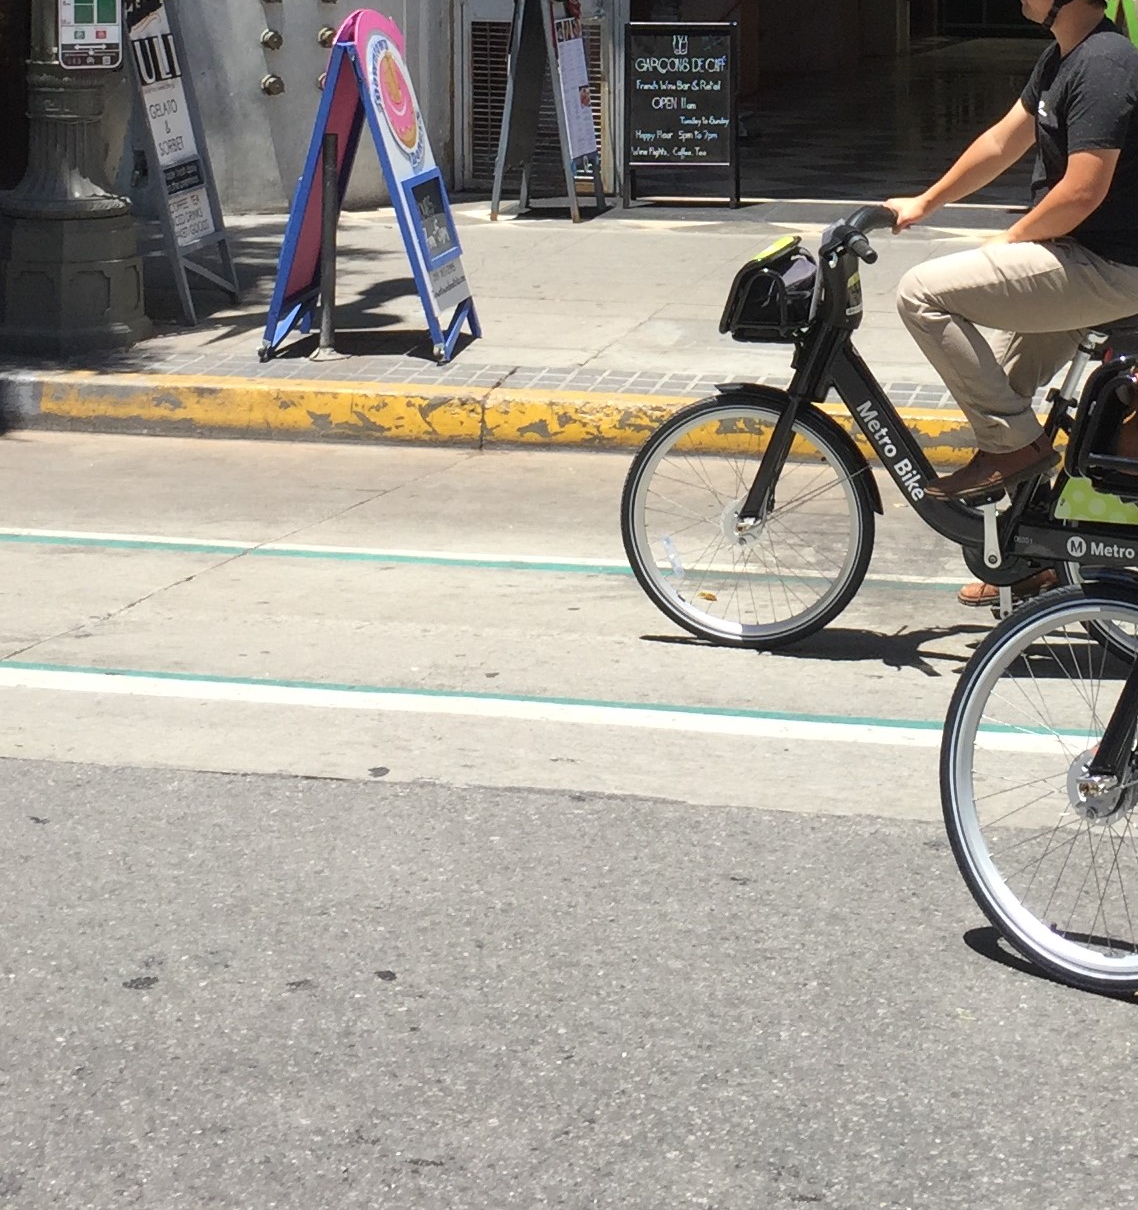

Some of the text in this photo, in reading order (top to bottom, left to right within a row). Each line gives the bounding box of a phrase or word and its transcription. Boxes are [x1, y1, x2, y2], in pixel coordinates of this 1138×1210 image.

[149, 99, 177, 119] GELATO
[652, 97, 677, 109] OPEN
[856, 400, 925, 502] Metro Bike
[1091, 542, 1135, 559] Metro
